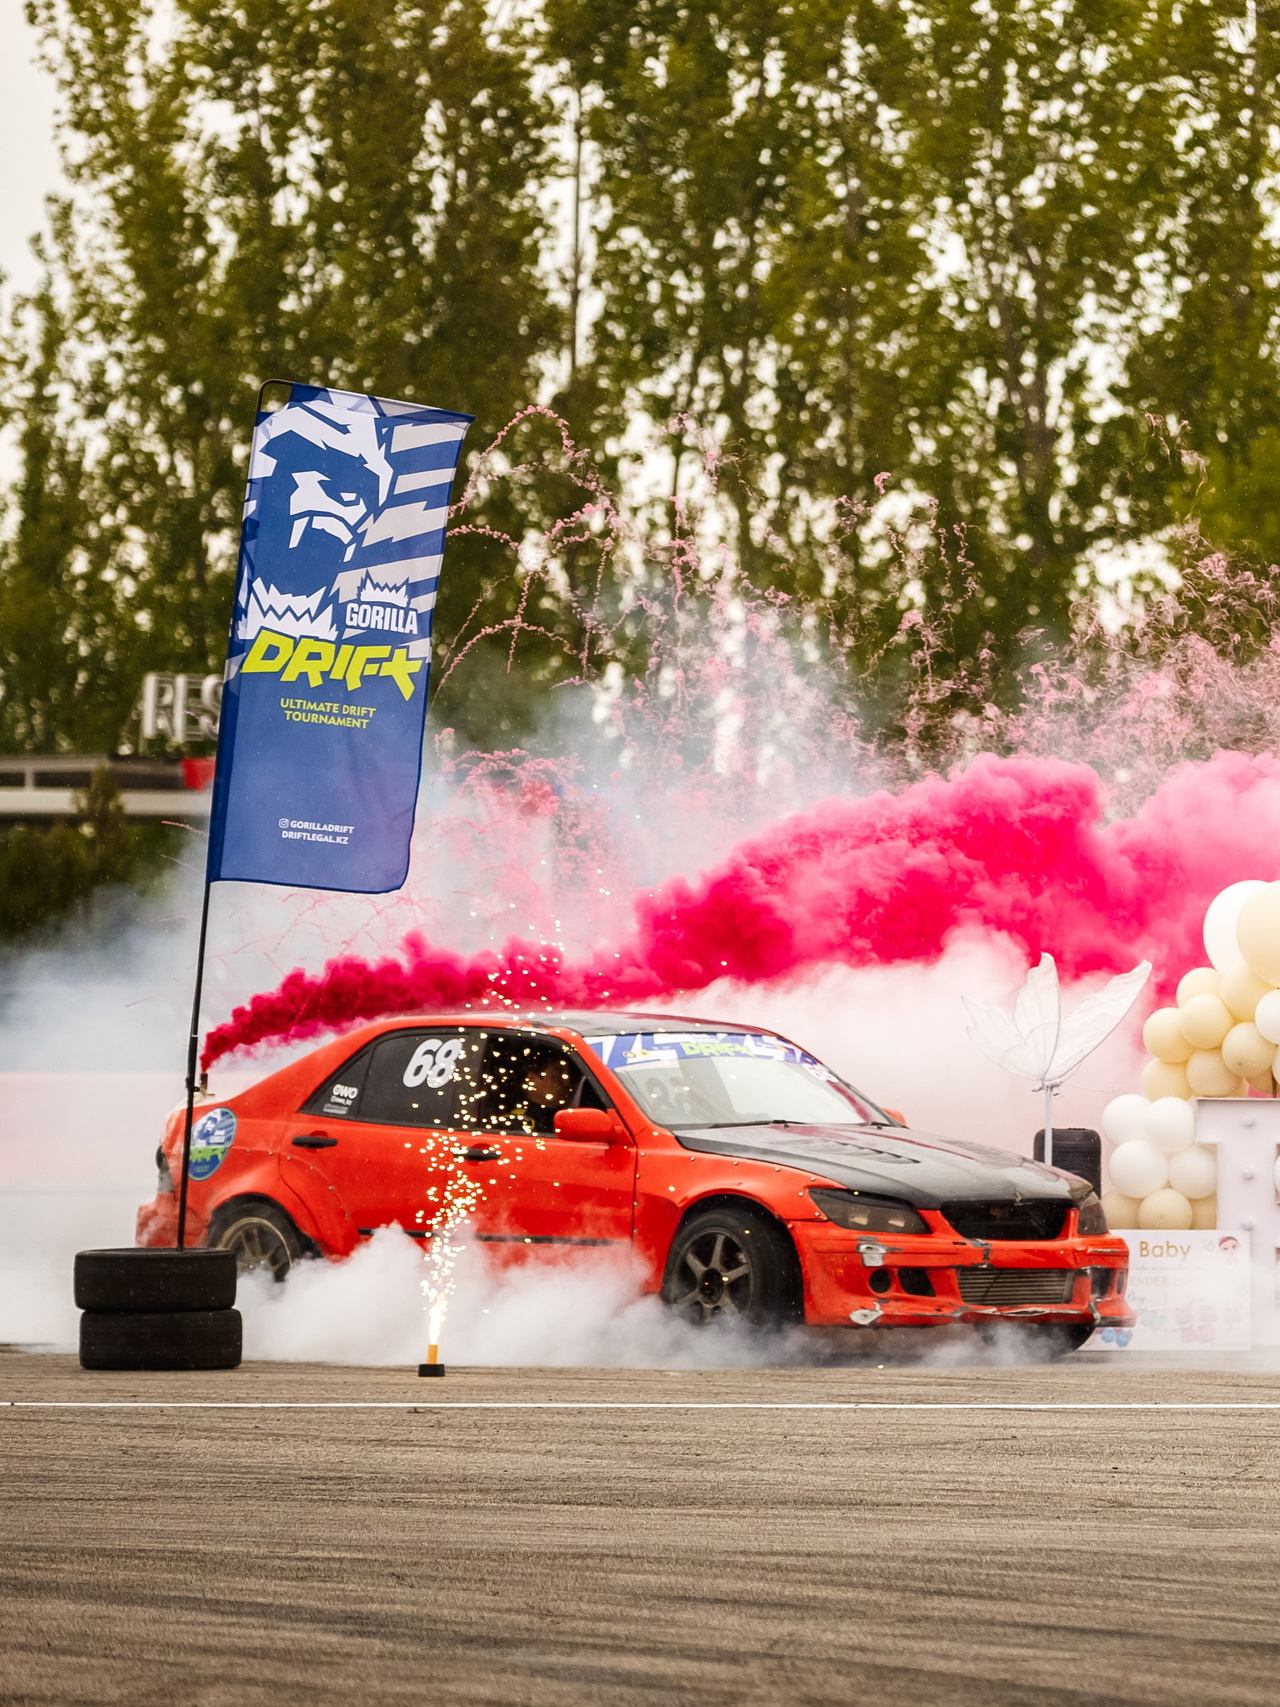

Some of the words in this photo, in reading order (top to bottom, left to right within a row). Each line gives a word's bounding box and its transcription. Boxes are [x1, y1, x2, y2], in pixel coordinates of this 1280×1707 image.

[346, 603, 418, 635] GORILLA
[240, 629, 423, 702] DRIFT
[280, 698, 339, 714] ULTIMATE
[342, 704, 376, 718] DRIFT
[284, 710, 370, 729] TOURNAMENT
[290, 820, 355, 834] GORILLADRIFT
[281, 830, 349, 845] DRIFTLEGAL.KZ
[680, 1042, 756, 1058] DRIFT
[403, 1038, 463, 1089] 68
[332, 1083, 359, 1100] OWO
[1139, 1240, 1191, 1261] Baby
